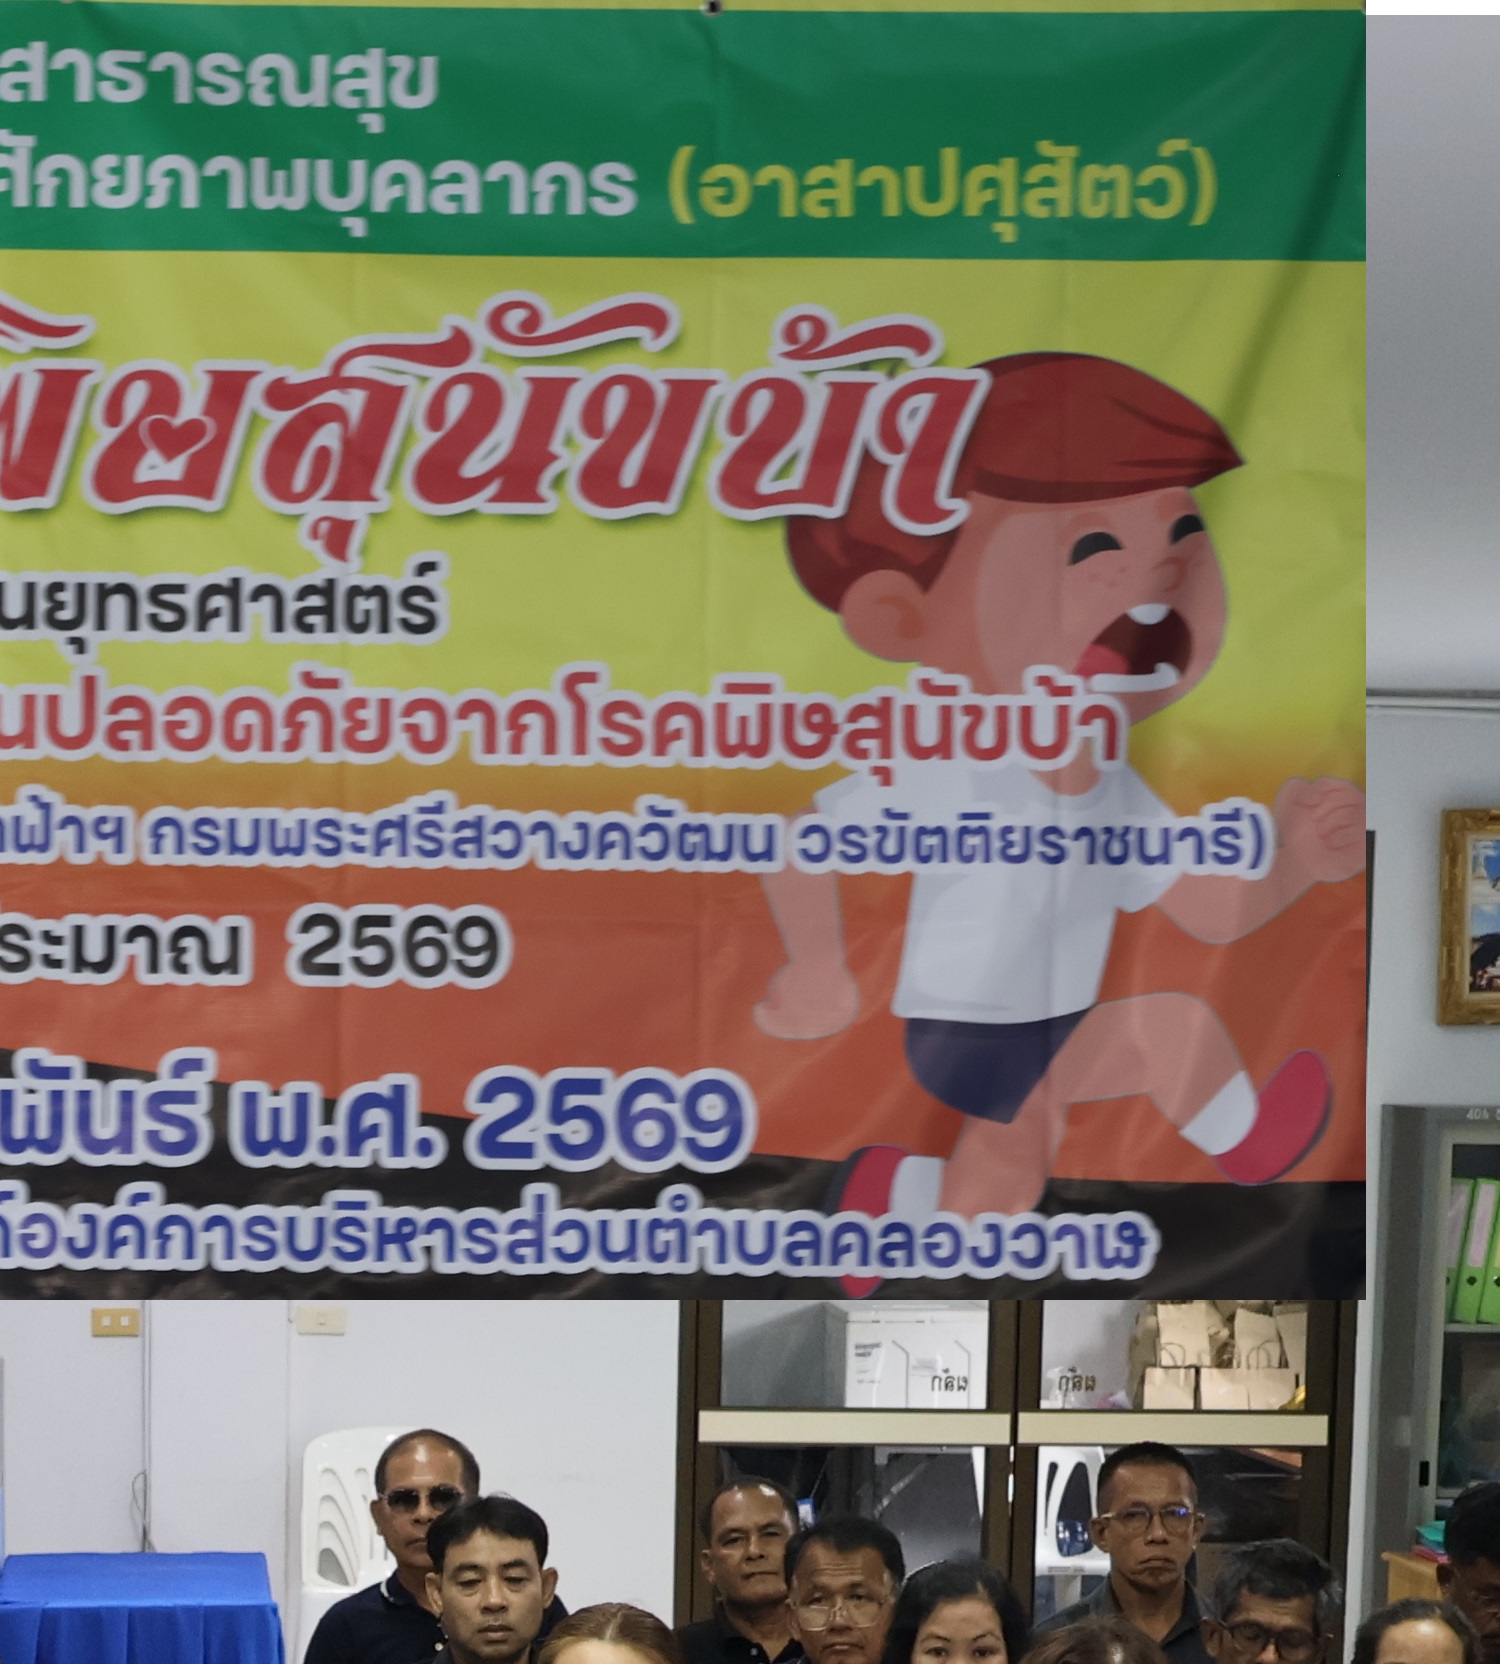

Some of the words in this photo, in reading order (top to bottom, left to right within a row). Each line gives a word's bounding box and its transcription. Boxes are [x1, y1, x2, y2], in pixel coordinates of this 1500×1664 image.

[668, 138, 1218, 242] (อาสาปศุสัตว์)
[146, 800, 778, 866] กรมพระศรีสวางควัฒน
[796, 806, 1268, 870] วรขัตติยราชนารี)
[296, 914, 500, 978] 2569
[234, 1085, 444, 1162] พ.ศ.
[476, 1078, 746, 1162] 2569
